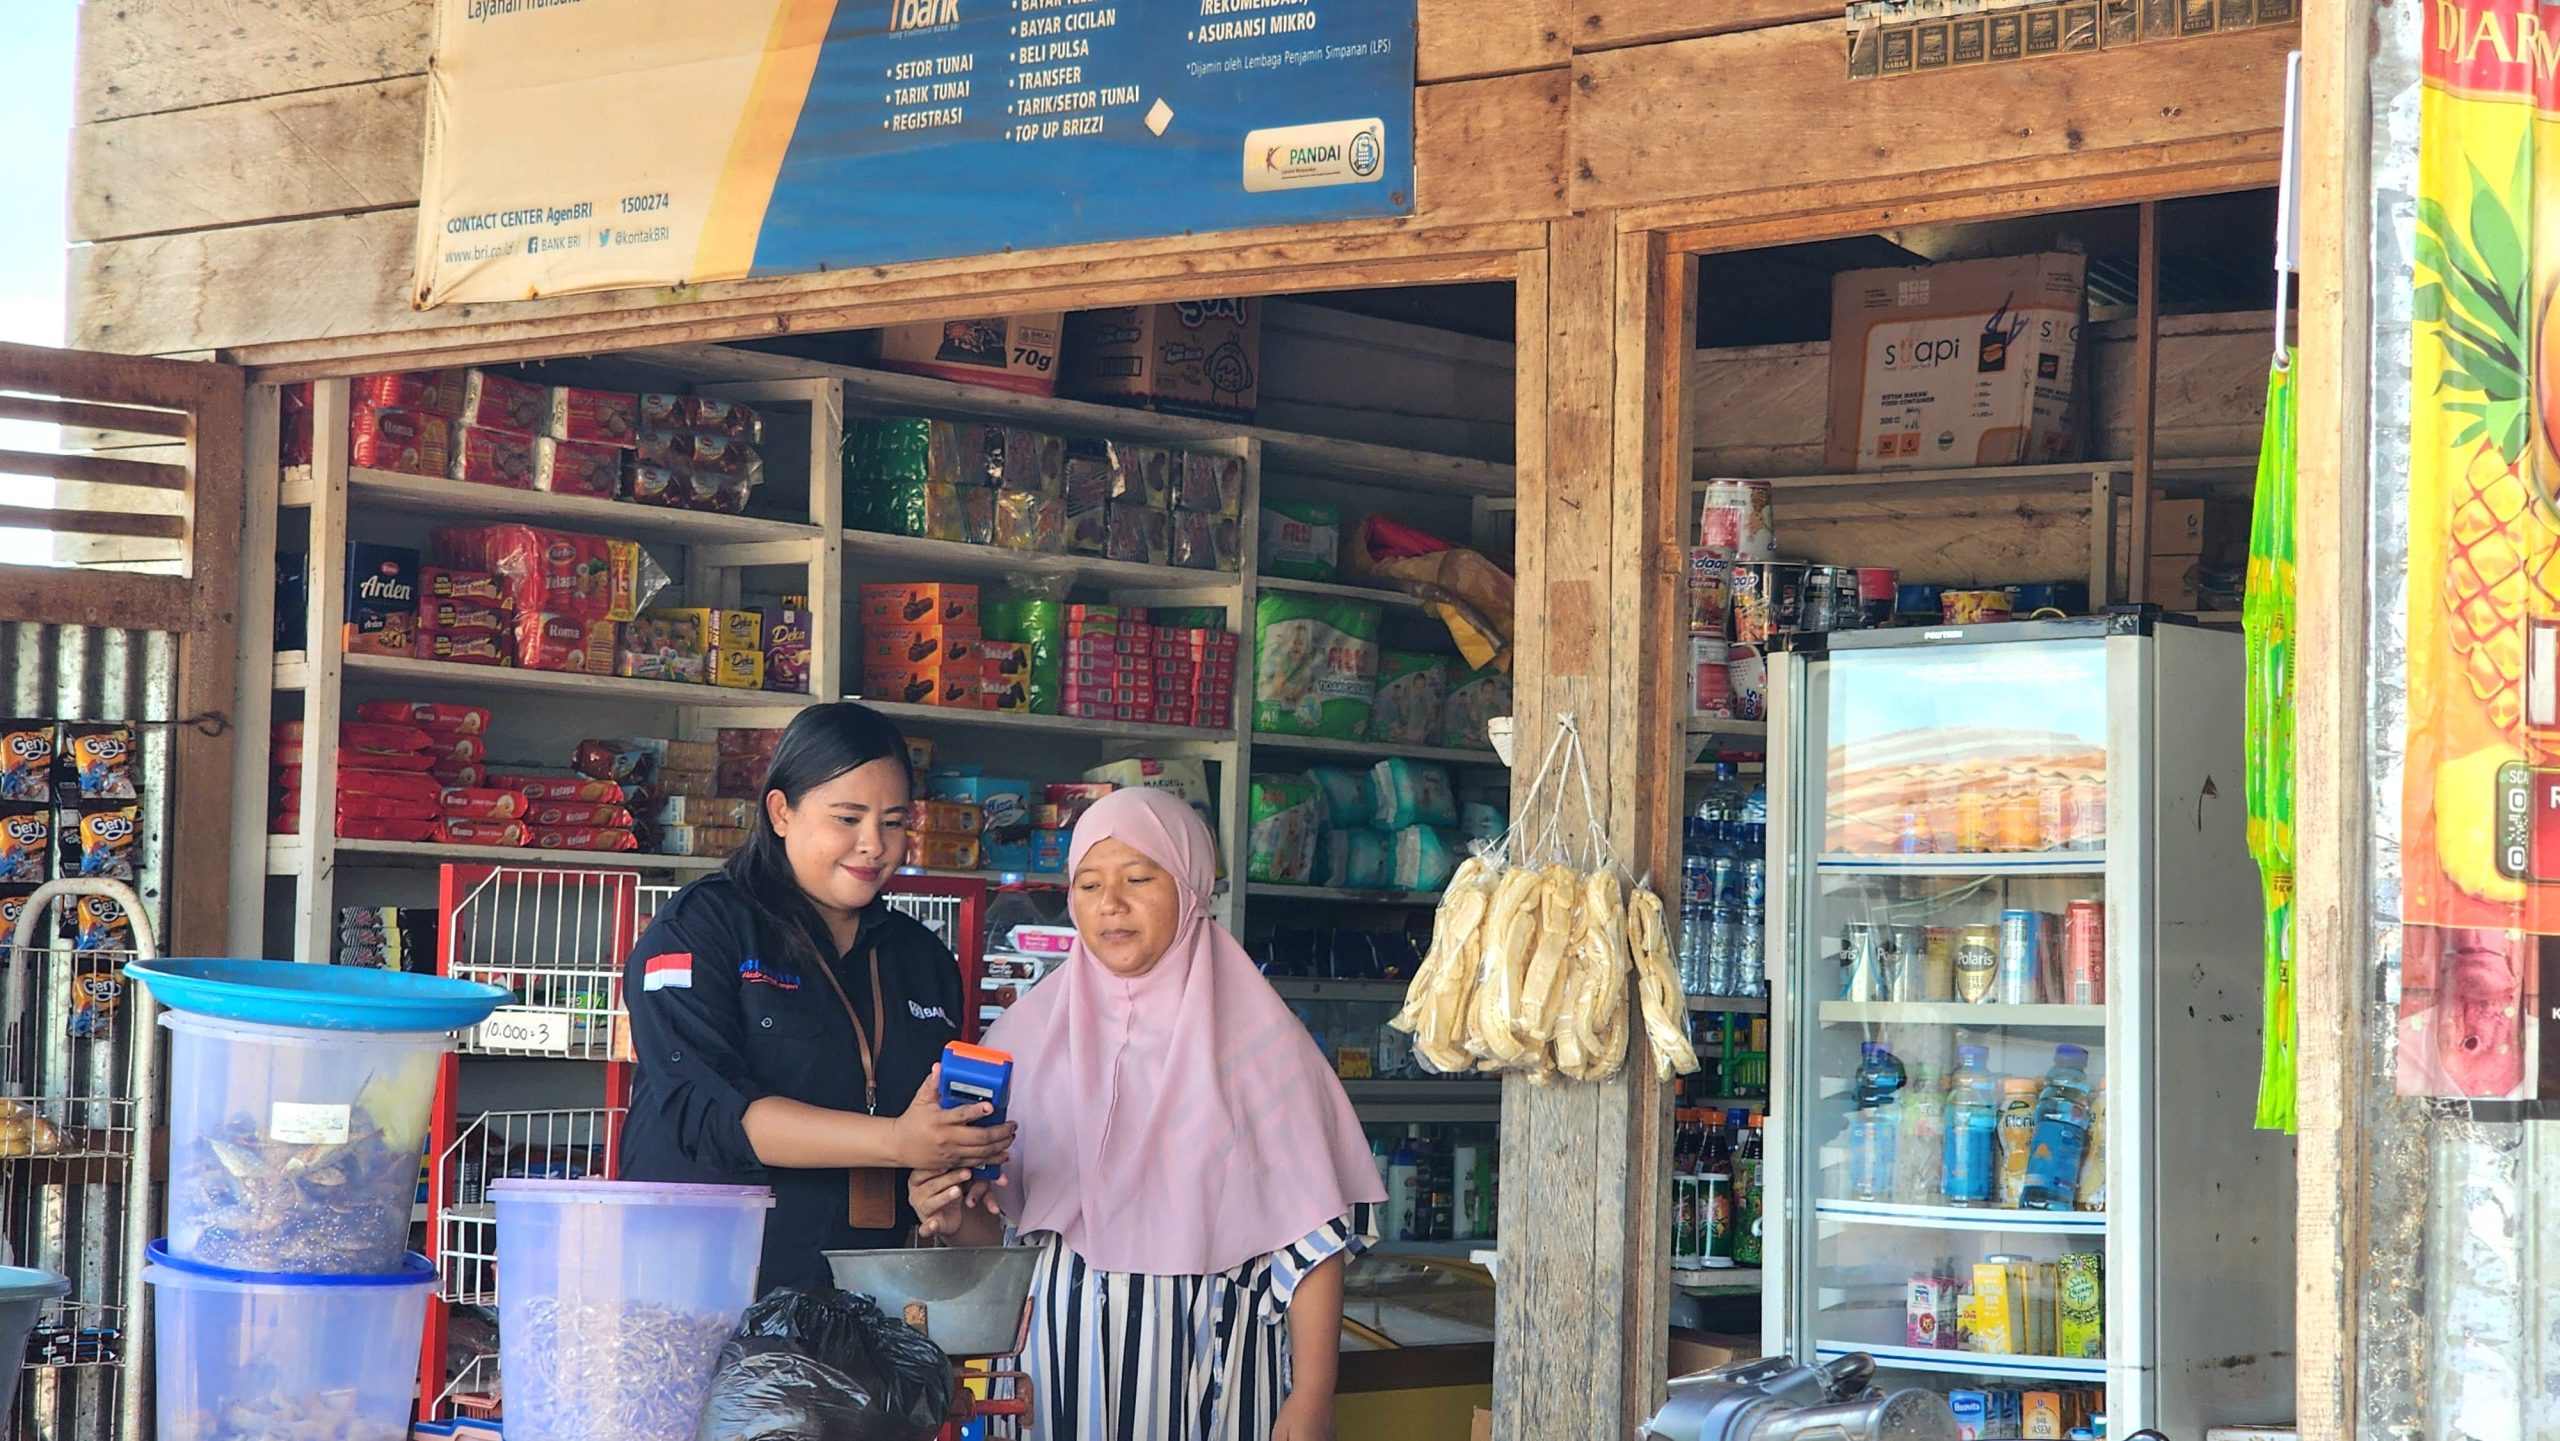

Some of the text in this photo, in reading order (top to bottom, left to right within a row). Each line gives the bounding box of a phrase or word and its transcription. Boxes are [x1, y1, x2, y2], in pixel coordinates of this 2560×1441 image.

[1020, 9, 1115, 38] BAYAR CICILAN
[1198, 12, 1316, 43] ASURANSI MIKRO
[1019, 39, 1089, 64] BELI PULSA
[1224, 58, 1242, 72] oleh
[1244, 54, 1282, 71] Lembaga
[1284, 50, 1323, 66] Penjamin
[1325, 44, 1367, 61] Simpanan
[1369, 38, 1391, 56] (LPS)
[895, 54, 974, 80] SETOR TUNAI
[1884, 59, 1909, 69] GARAM
[1018, 66, 1081, 90] TRANSFER
[894, 80, 970, 106] TARIK TUNAI
[1017, 85, 1140, 117] TARIK/SETOR TUNAI
[892, 107, 963, 131] REGISTRASI
[1015, 116, 1104, 142] TOP UP BRIZZI
[1289, 145, 1341, 165] PANDAI
[447, 192, 669, 234] CONTACT CENTER AgenBRI 1500274
[445, 227, 669, 263] www.bri.co.id BANK BRI @kontakBRI
[1013, 347, 1052, 372] 70g
[383, 419, 414, 438] Roma
[360, 575, 413, 600] Arden
[549, 624, 581, 639] Roma
[730, 613, 753, 629] Deka
[772, 624, 806, 644] Deka
[731, 651, 755, 667] Deka
[12, 737, 51, 760] Gery
[84, 739, 127, 758] Gery
[7, 820, 47, 844] Gery
[90, 817, 134, 840] Gery
[2, 901, 23, 921] Ge
[1957, 951, 1995, 966] Polaris
